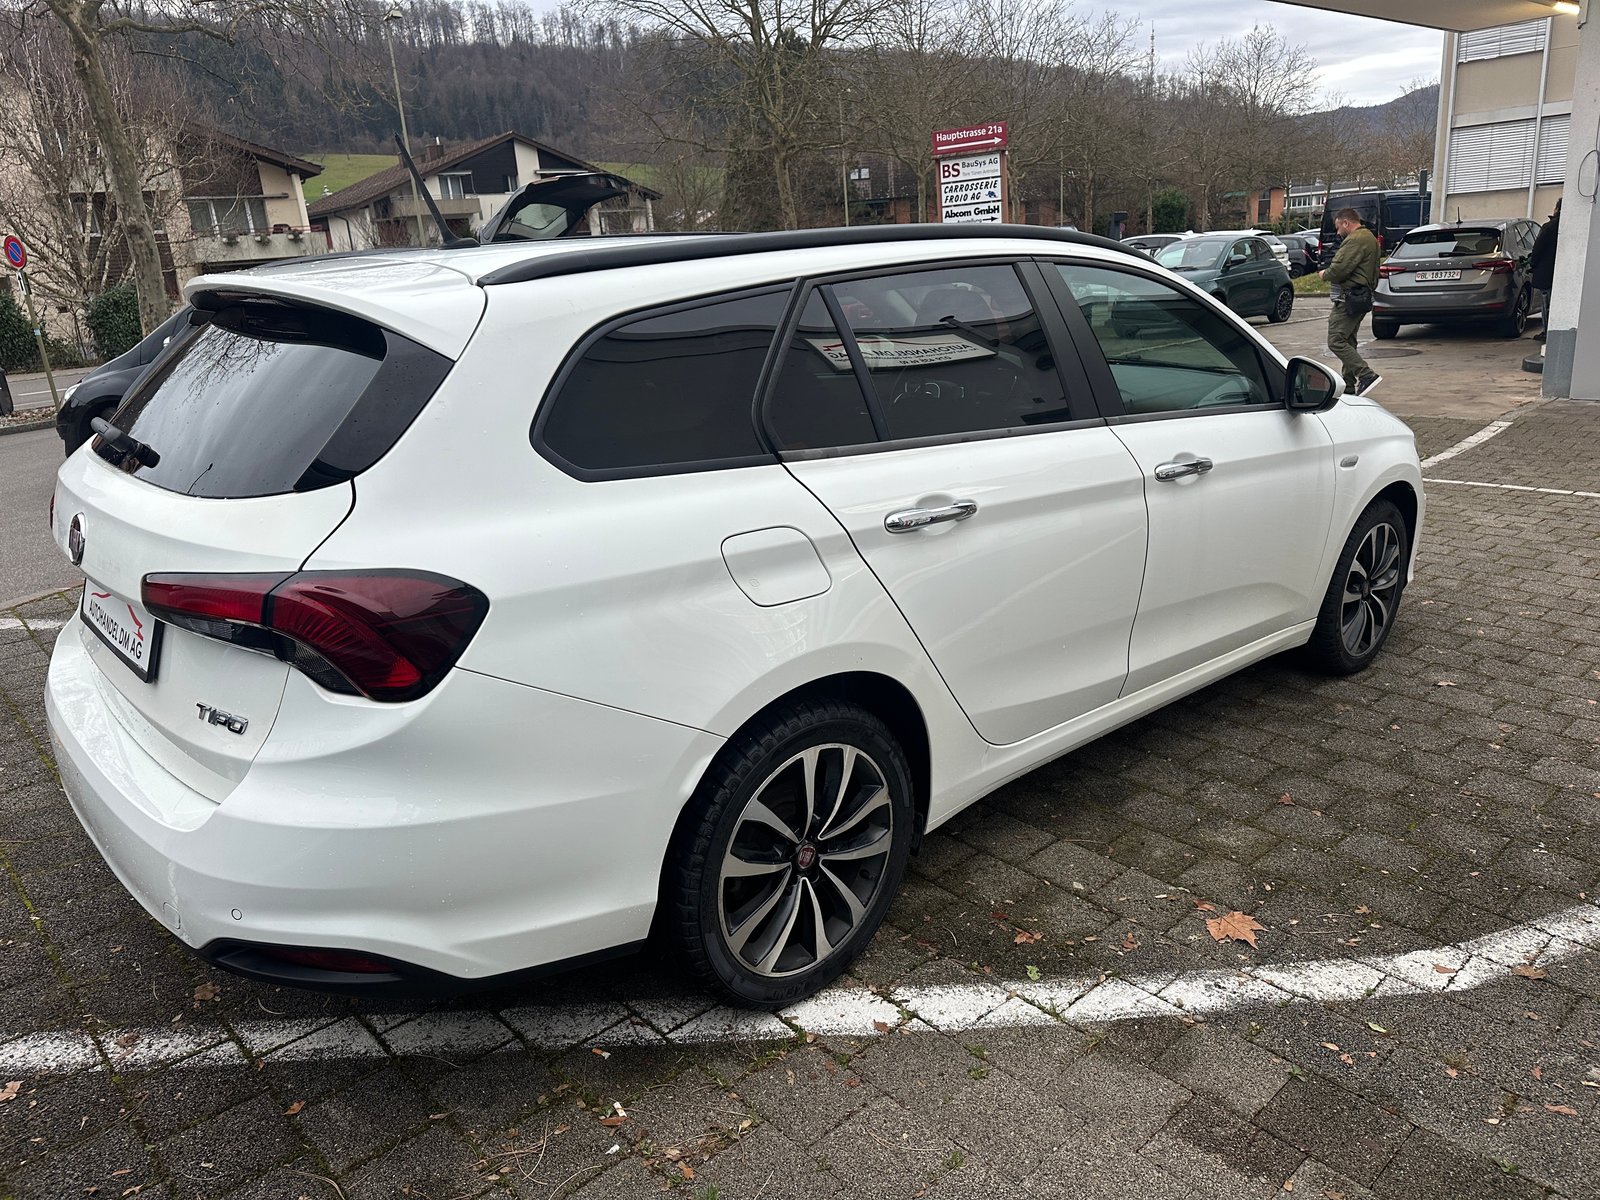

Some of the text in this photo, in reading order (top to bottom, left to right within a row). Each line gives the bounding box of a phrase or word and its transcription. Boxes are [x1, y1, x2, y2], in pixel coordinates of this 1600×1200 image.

[936, 125, 1003, 142] Hauptstrasse 21a
[961, 157, 998, 168] BauSys AG
[942, 163, 960, 178] BS
[944, 180, 998, 194] CARROSSERIE
[970, 192, 981, 200] AG
[944, 205, 1000, 219] Abcom GmbH
[89, 599, 143, 660] AUTOHANDEL DM AG
[196, 701, 249, 735] TIPO
